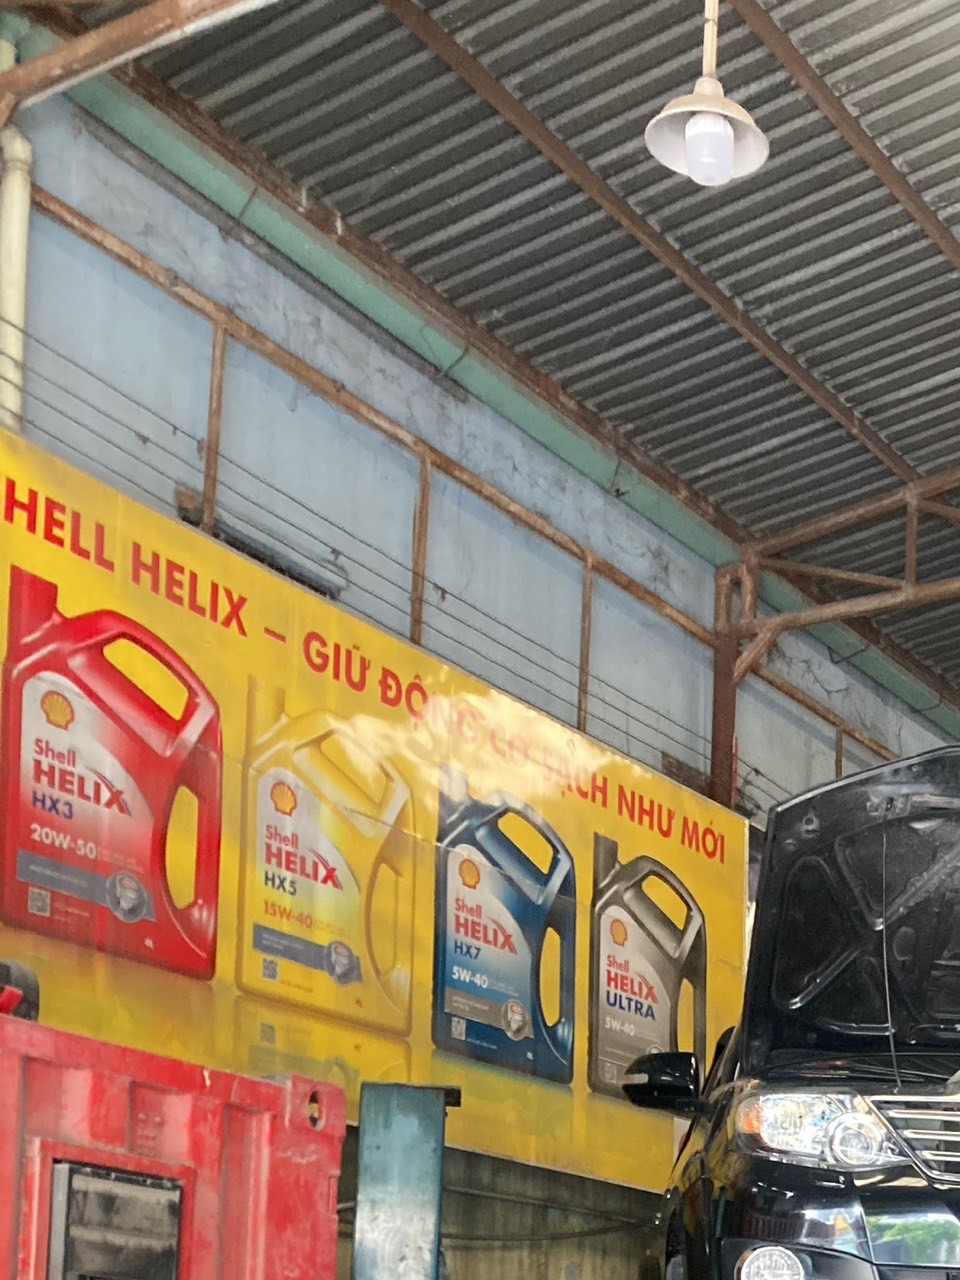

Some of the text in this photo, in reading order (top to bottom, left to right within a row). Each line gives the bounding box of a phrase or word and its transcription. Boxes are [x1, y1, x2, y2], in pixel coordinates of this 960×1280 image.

[4, 477, 115, 574] HELL
[131, 540, 248, 638] HELIX
[303, 630, 371, 693] GIỮ
[617, 783, 676, 839] NHƯ
[680, 814, 726, 865] MỚI
[33, 738, 76, 768] Shell
[32, 757, 132, 817] HELIX
[31, 790, 74, 820] HX3
[30, 823, 97, 860] 20W-50
[265, 823, 299, 850] Shell
[264, 842, 343, 890] HELIX
[264, 870, 297, 896] HX5
[263, 900, 313, 929] 15W-40
[454, 897, 482, 919] Shell
[454, 914, 517, 955] HELIX
[453, 940, 481, 961] HX7
[606, 953, 630, 973] Shell
[451, 966, 489, 989] 5W-40
[606, 969, 659, 1005] HELIX
[605, 990, 656, 1022] ULTRA
[604, 1016, 636, 1037] 5W-40
